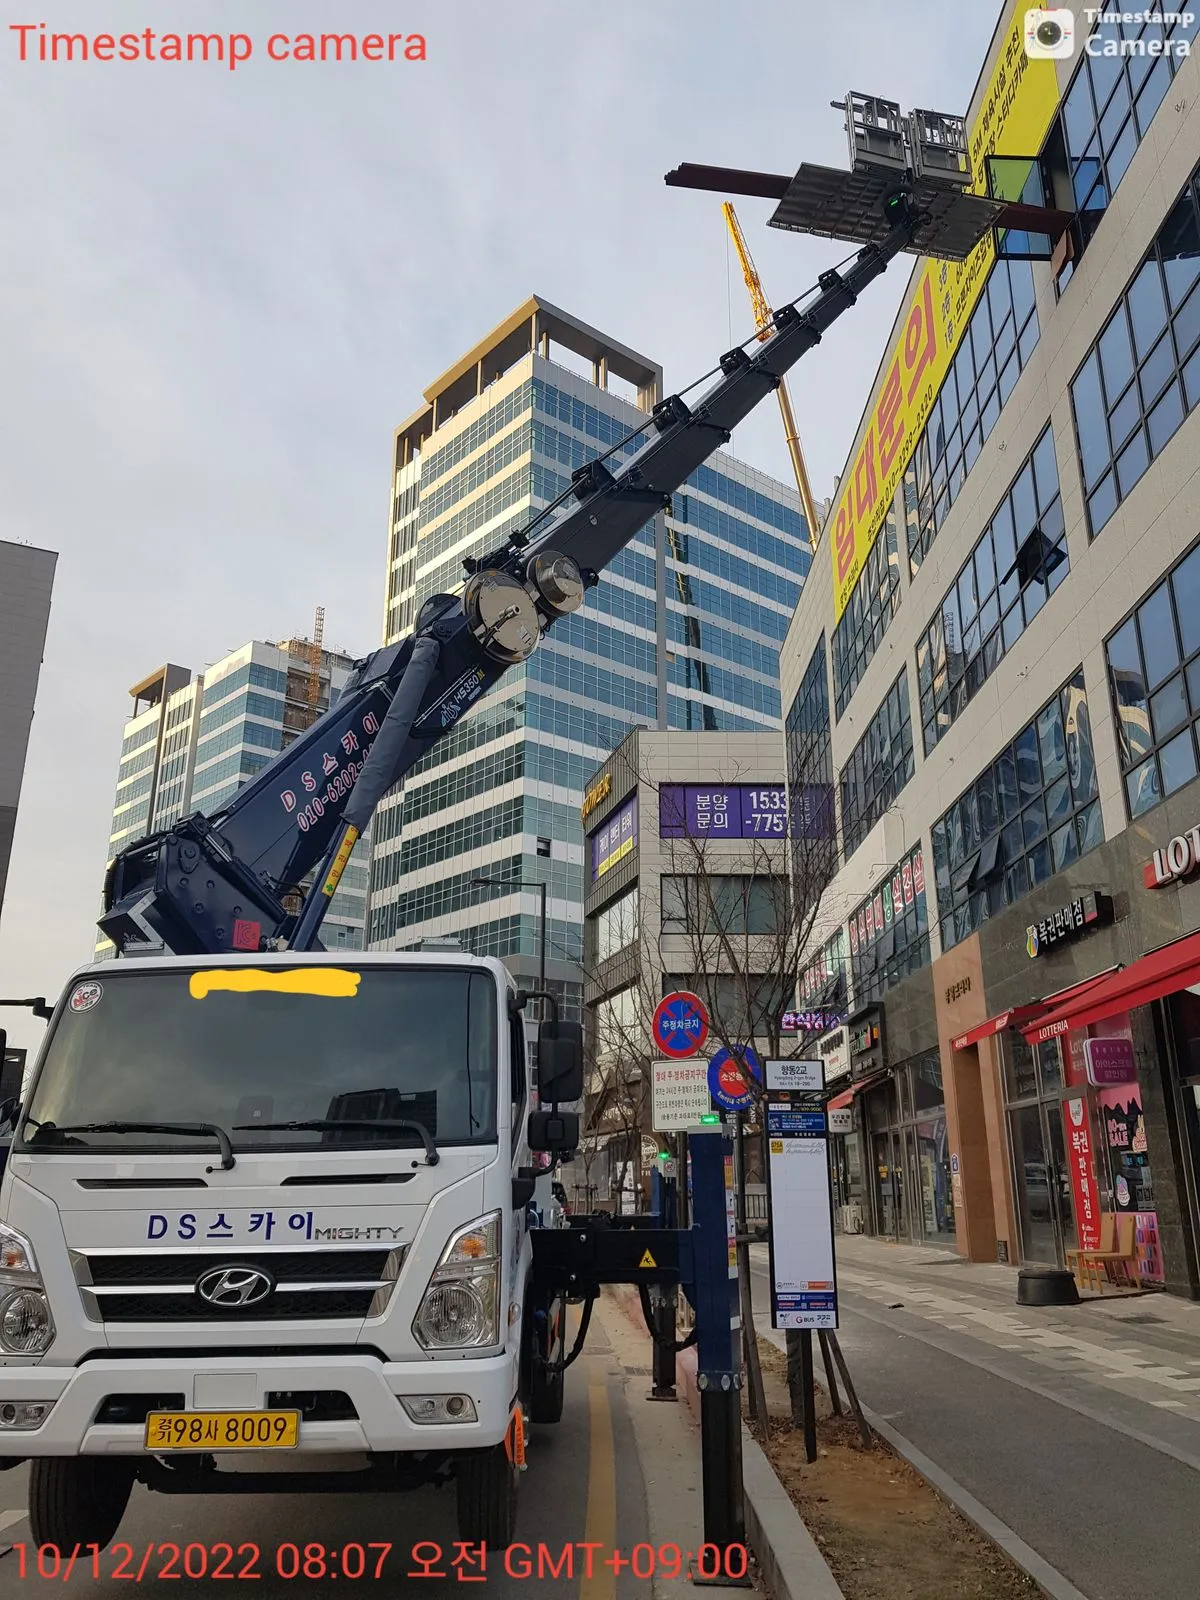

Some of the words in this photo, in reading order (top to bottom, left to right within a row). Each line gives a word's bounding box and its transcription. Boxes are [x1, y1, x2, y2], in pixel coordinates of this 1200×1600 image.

[835, 272, 937, 583] 임대문의
[696, 794, 729, 811] 분양
[696, 812, 729, 830] 문의
[1038, 897, 1084, 945] 복권판매점
[662, 1018, 699, 1030] 주정차금지
[1039, 1019, 1069, 1039] LOTTERIA
[781, 1065, 808, 1076] 향동2교
[1072, 1131, 1089, 1154] 복권
[1078, 1156, 1093, 1219] 판매점
[314, 1226, 405, 1240] MIGHTY
[173, 1416, 219, 1444] 98사
[224, 1416, 288, 1444] 8009
